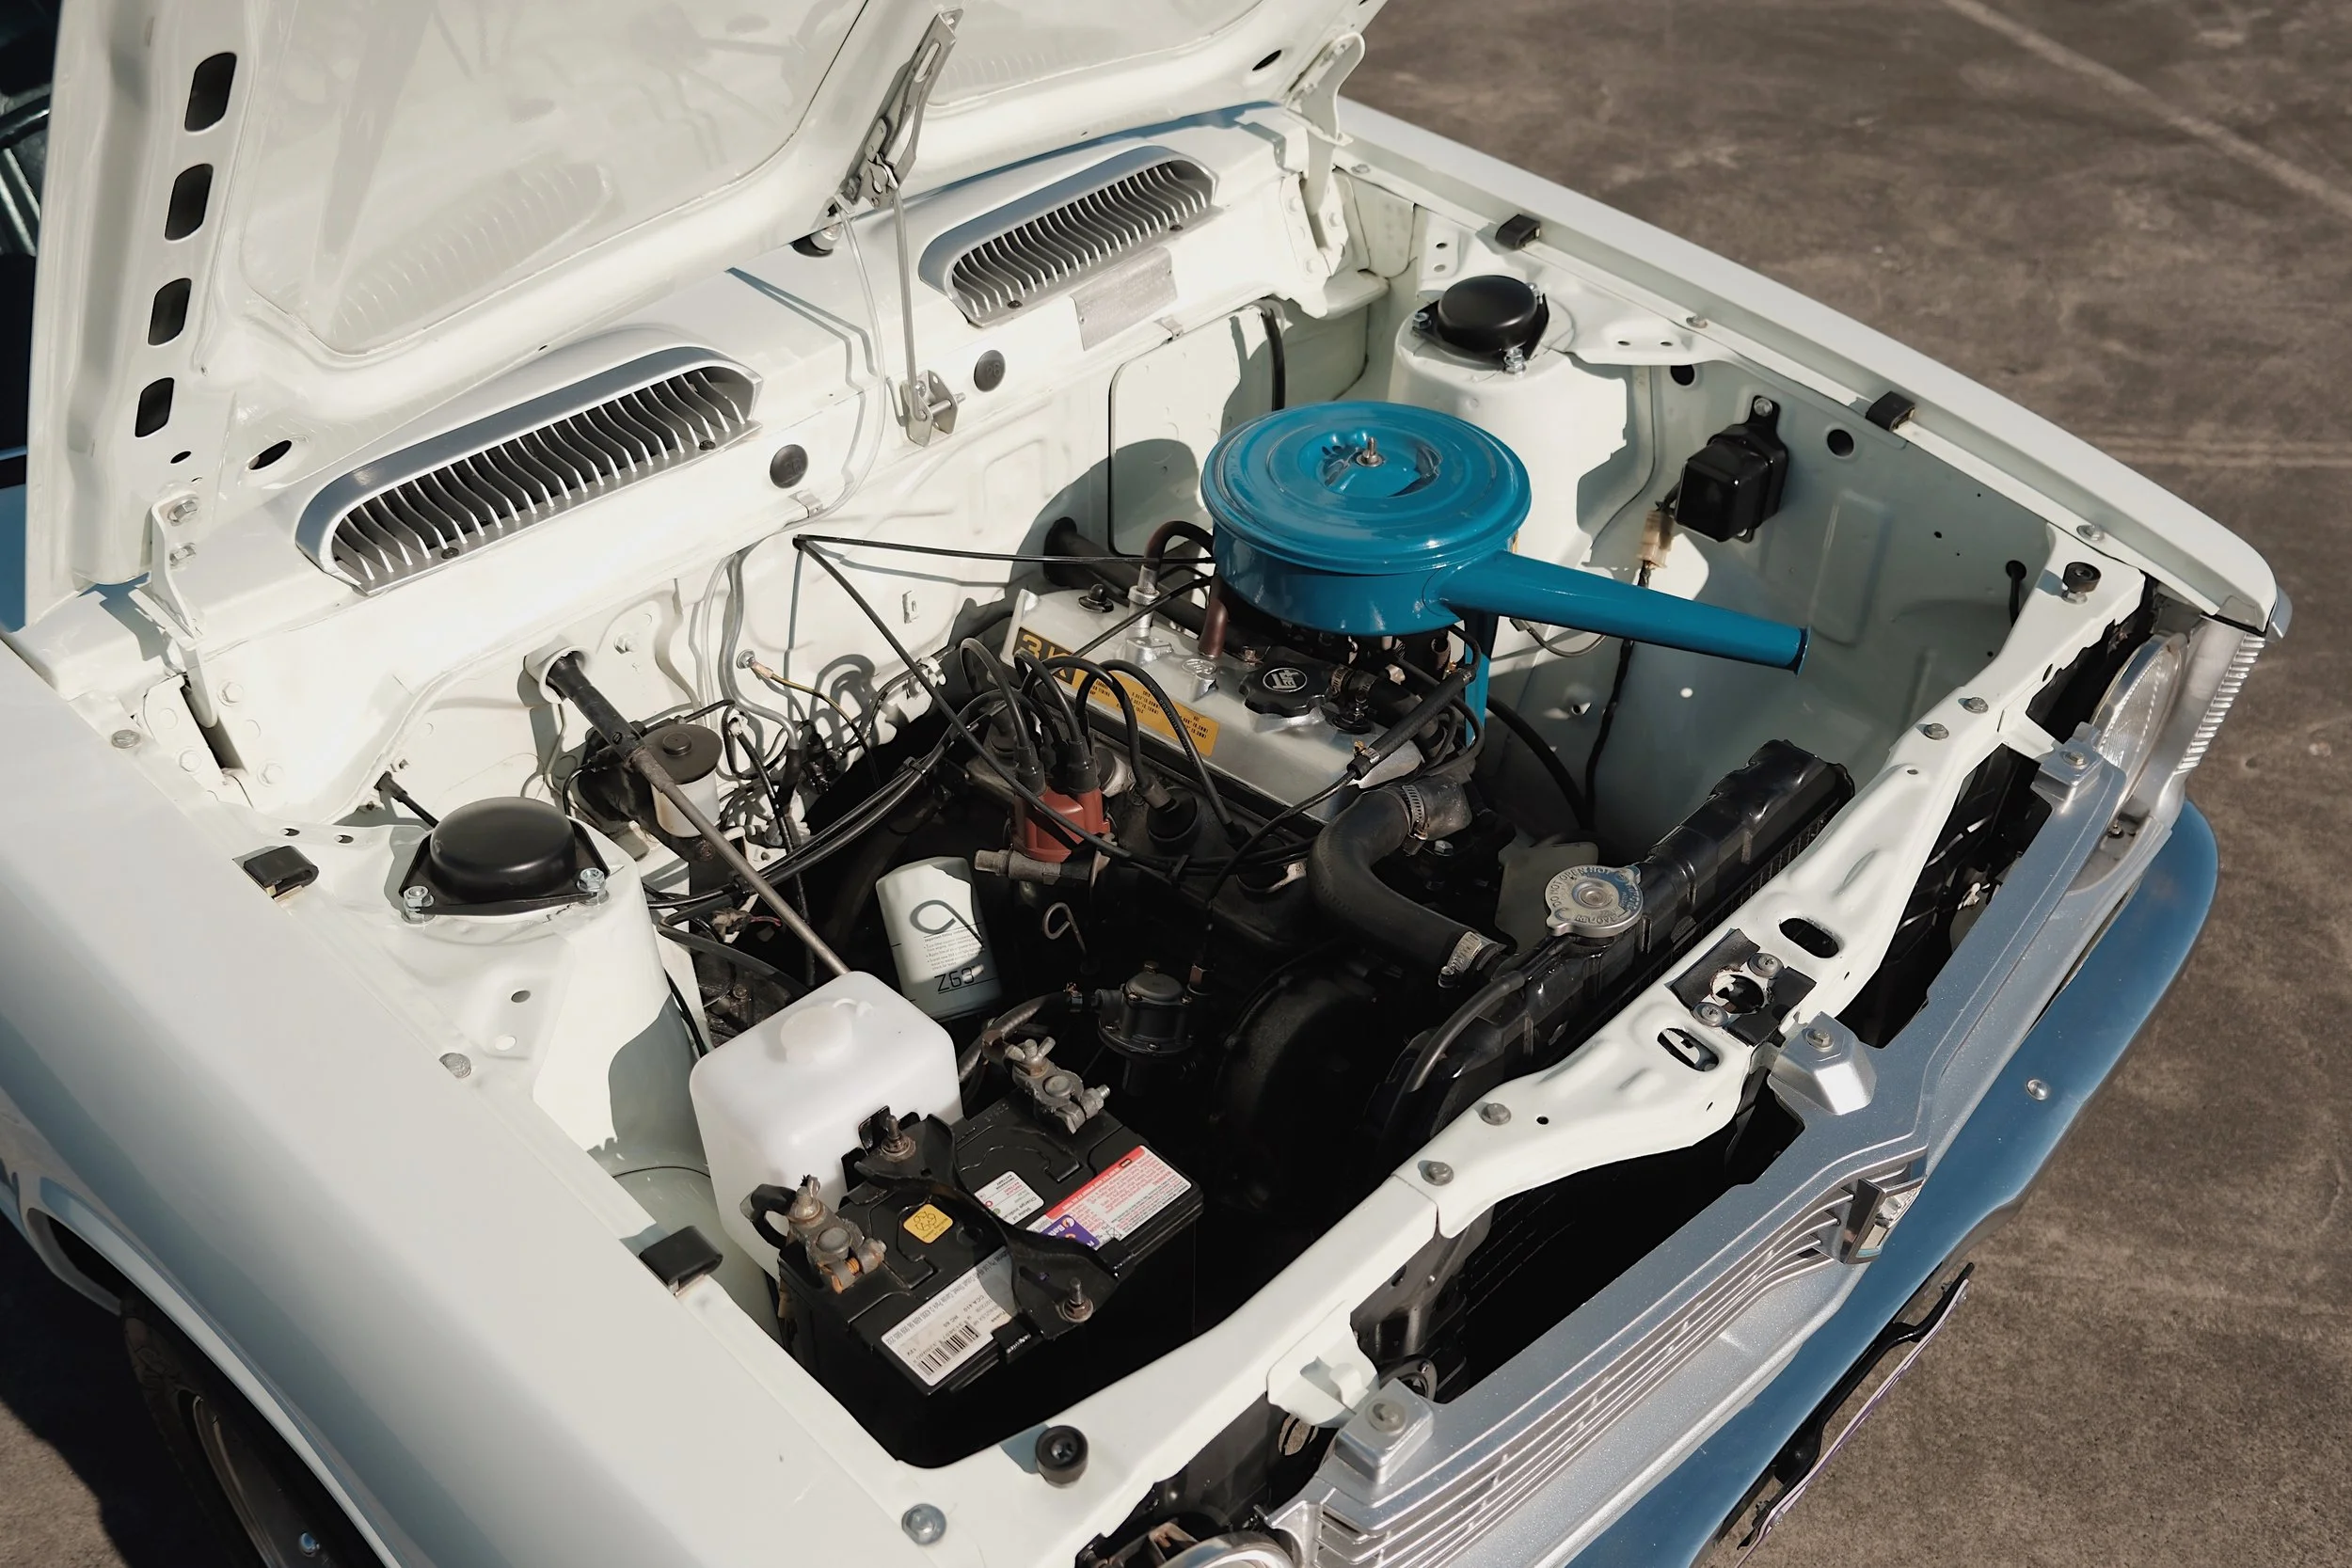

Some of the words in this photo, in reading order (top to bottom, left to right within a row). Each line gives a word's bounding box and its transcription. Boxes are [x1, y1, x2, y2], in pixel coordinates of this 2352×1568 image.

[1550, 880, 1564, 895] NOT
[1559, 866, 1586, 882] OPEN
[1587, 866, 1612, 876] HOT
[1019, 1196, 1037, 1209] Charge
[1019, 1207, 1031, 1216] State
